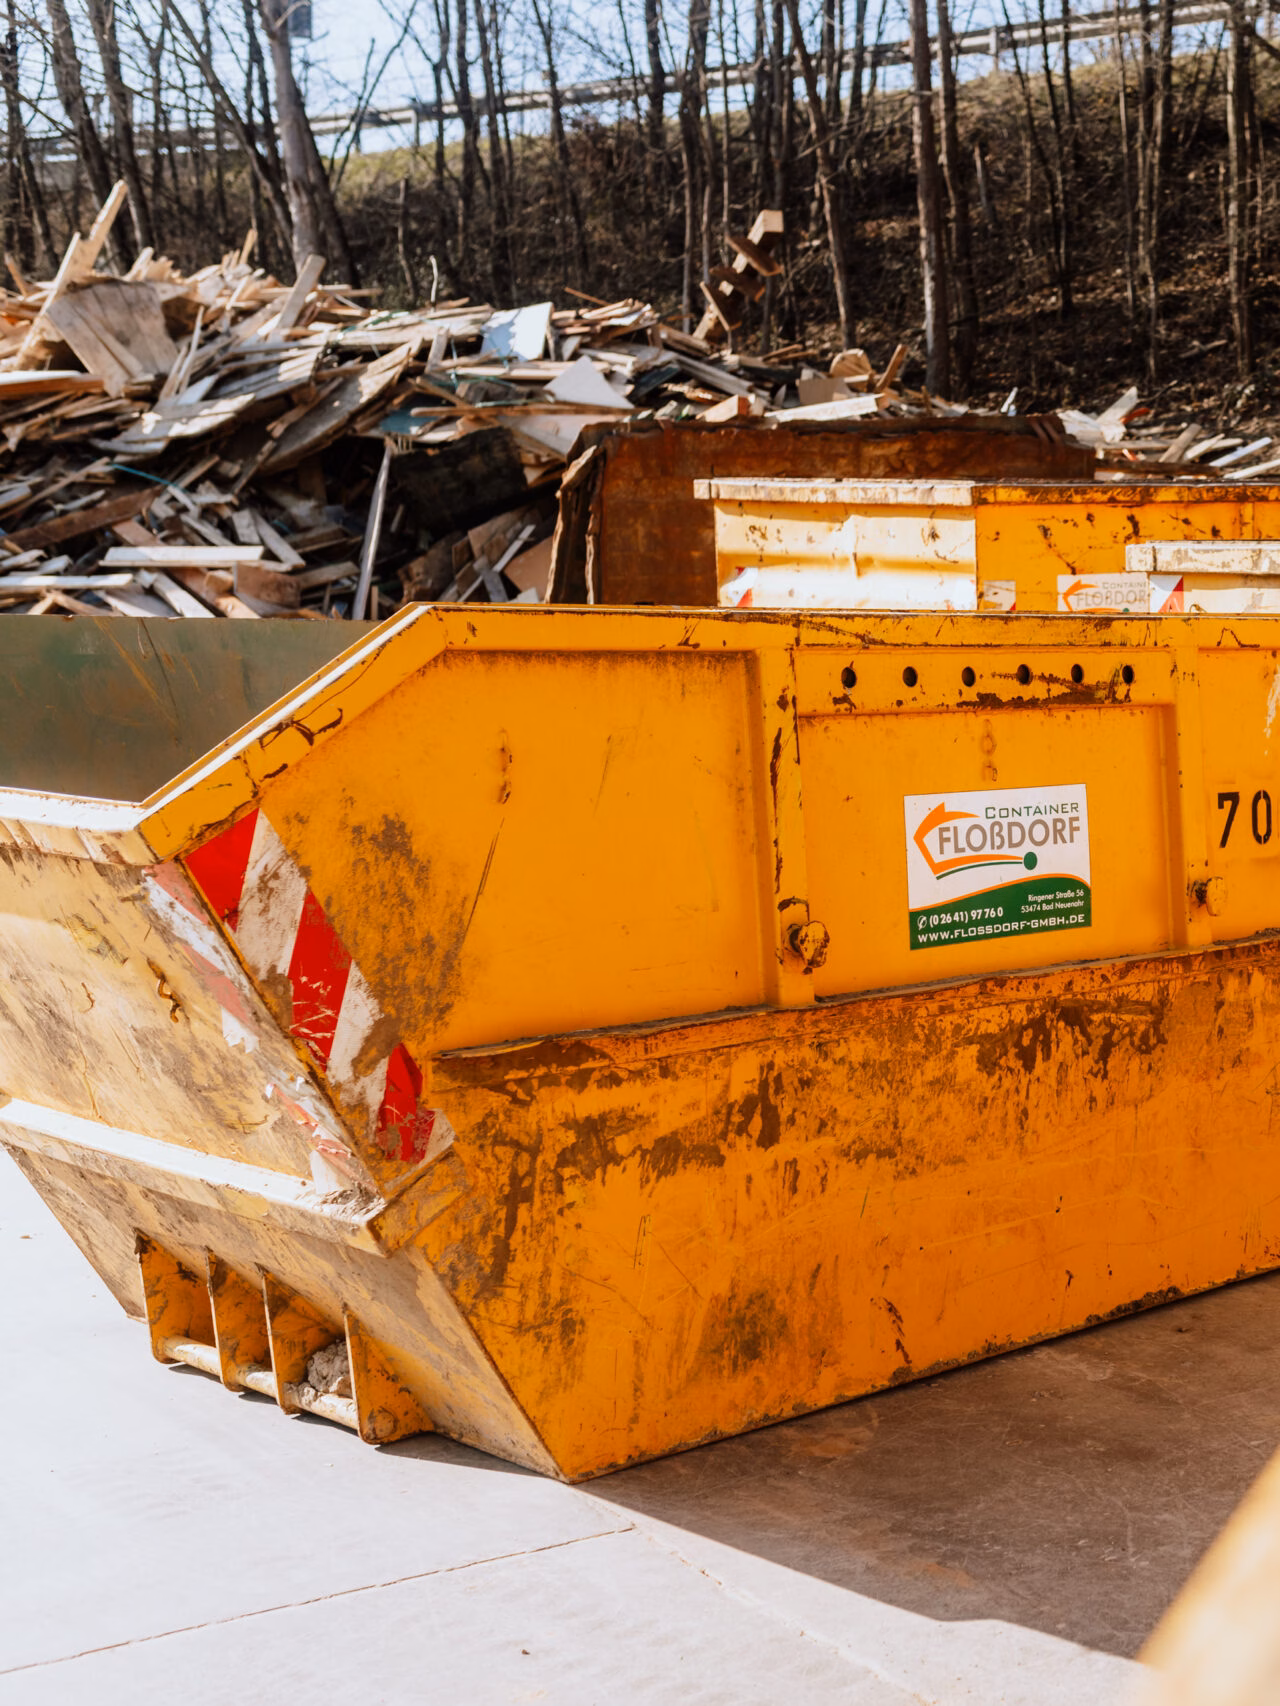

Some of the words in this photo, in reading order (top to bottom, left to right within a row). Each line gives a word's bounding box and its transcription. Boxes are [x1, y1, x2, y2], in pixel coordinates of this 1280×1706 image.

[1076, 590, 1147, 607] FLOßDOR
[985, 802, 1079, 819] CONTAINER
[938, 816, 1081, 855] FLOßDORF
[1028, 893, 1054, 902] Ringener
[1055, 889, 1075, 899] Straße
[1076, 889, 1085, 897] 56
[1020, 904, 1041, 914] 53474
[1042, 902, 1054, 911] Bad
[1055, 900, 1085, 909] Neuenahr
